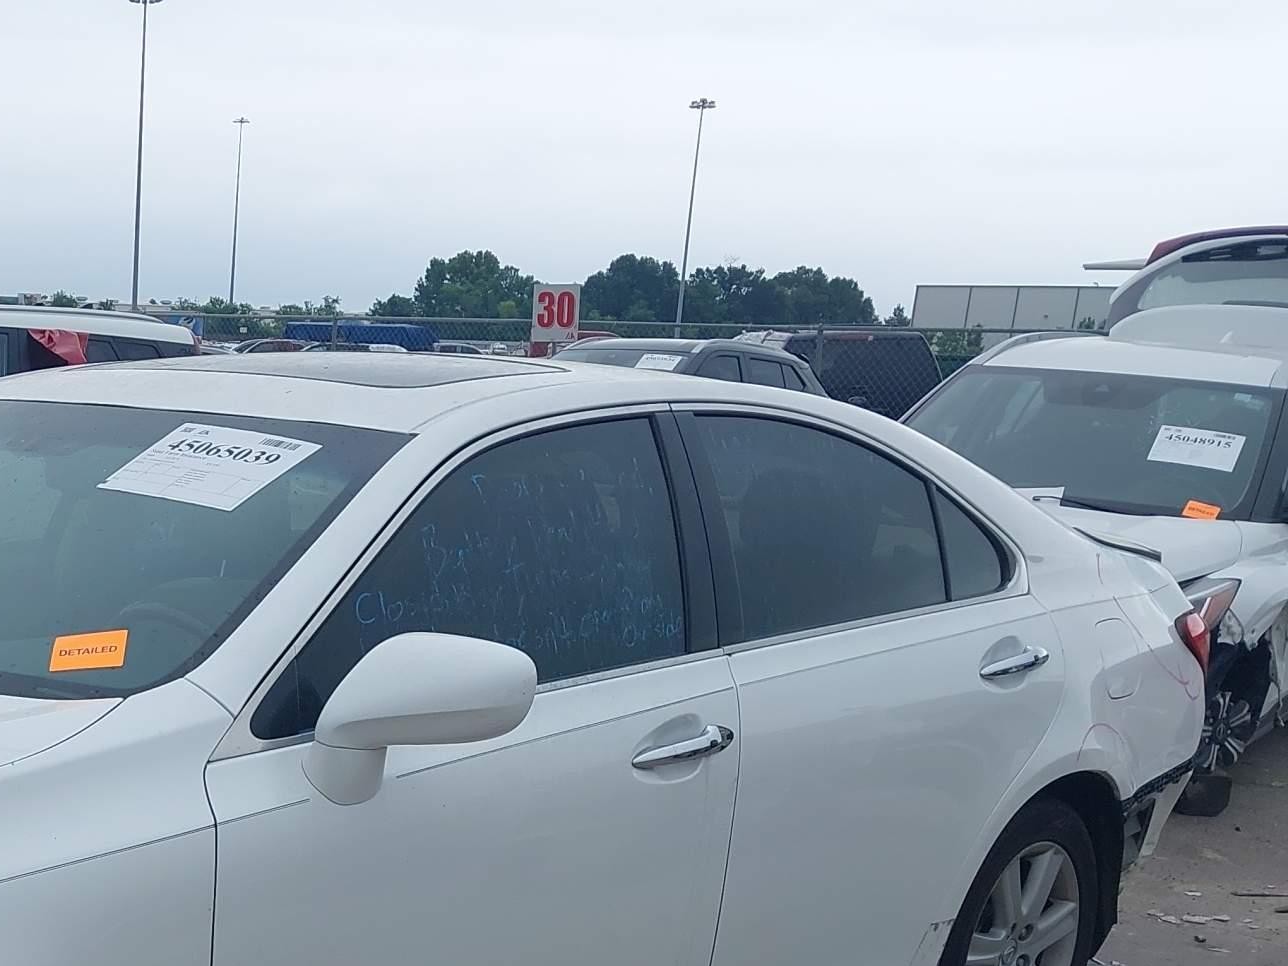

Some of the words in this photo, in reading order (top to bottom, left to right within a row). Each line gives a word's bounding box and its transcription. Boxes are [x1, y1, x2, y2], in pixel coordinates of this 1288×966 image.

[536, 290, 576, 328] 30
[1165, 433, 1232, 448] 45048915
[168, 439, 281, 465] 45065039
[58, 645, 118, 657] DETAILED
